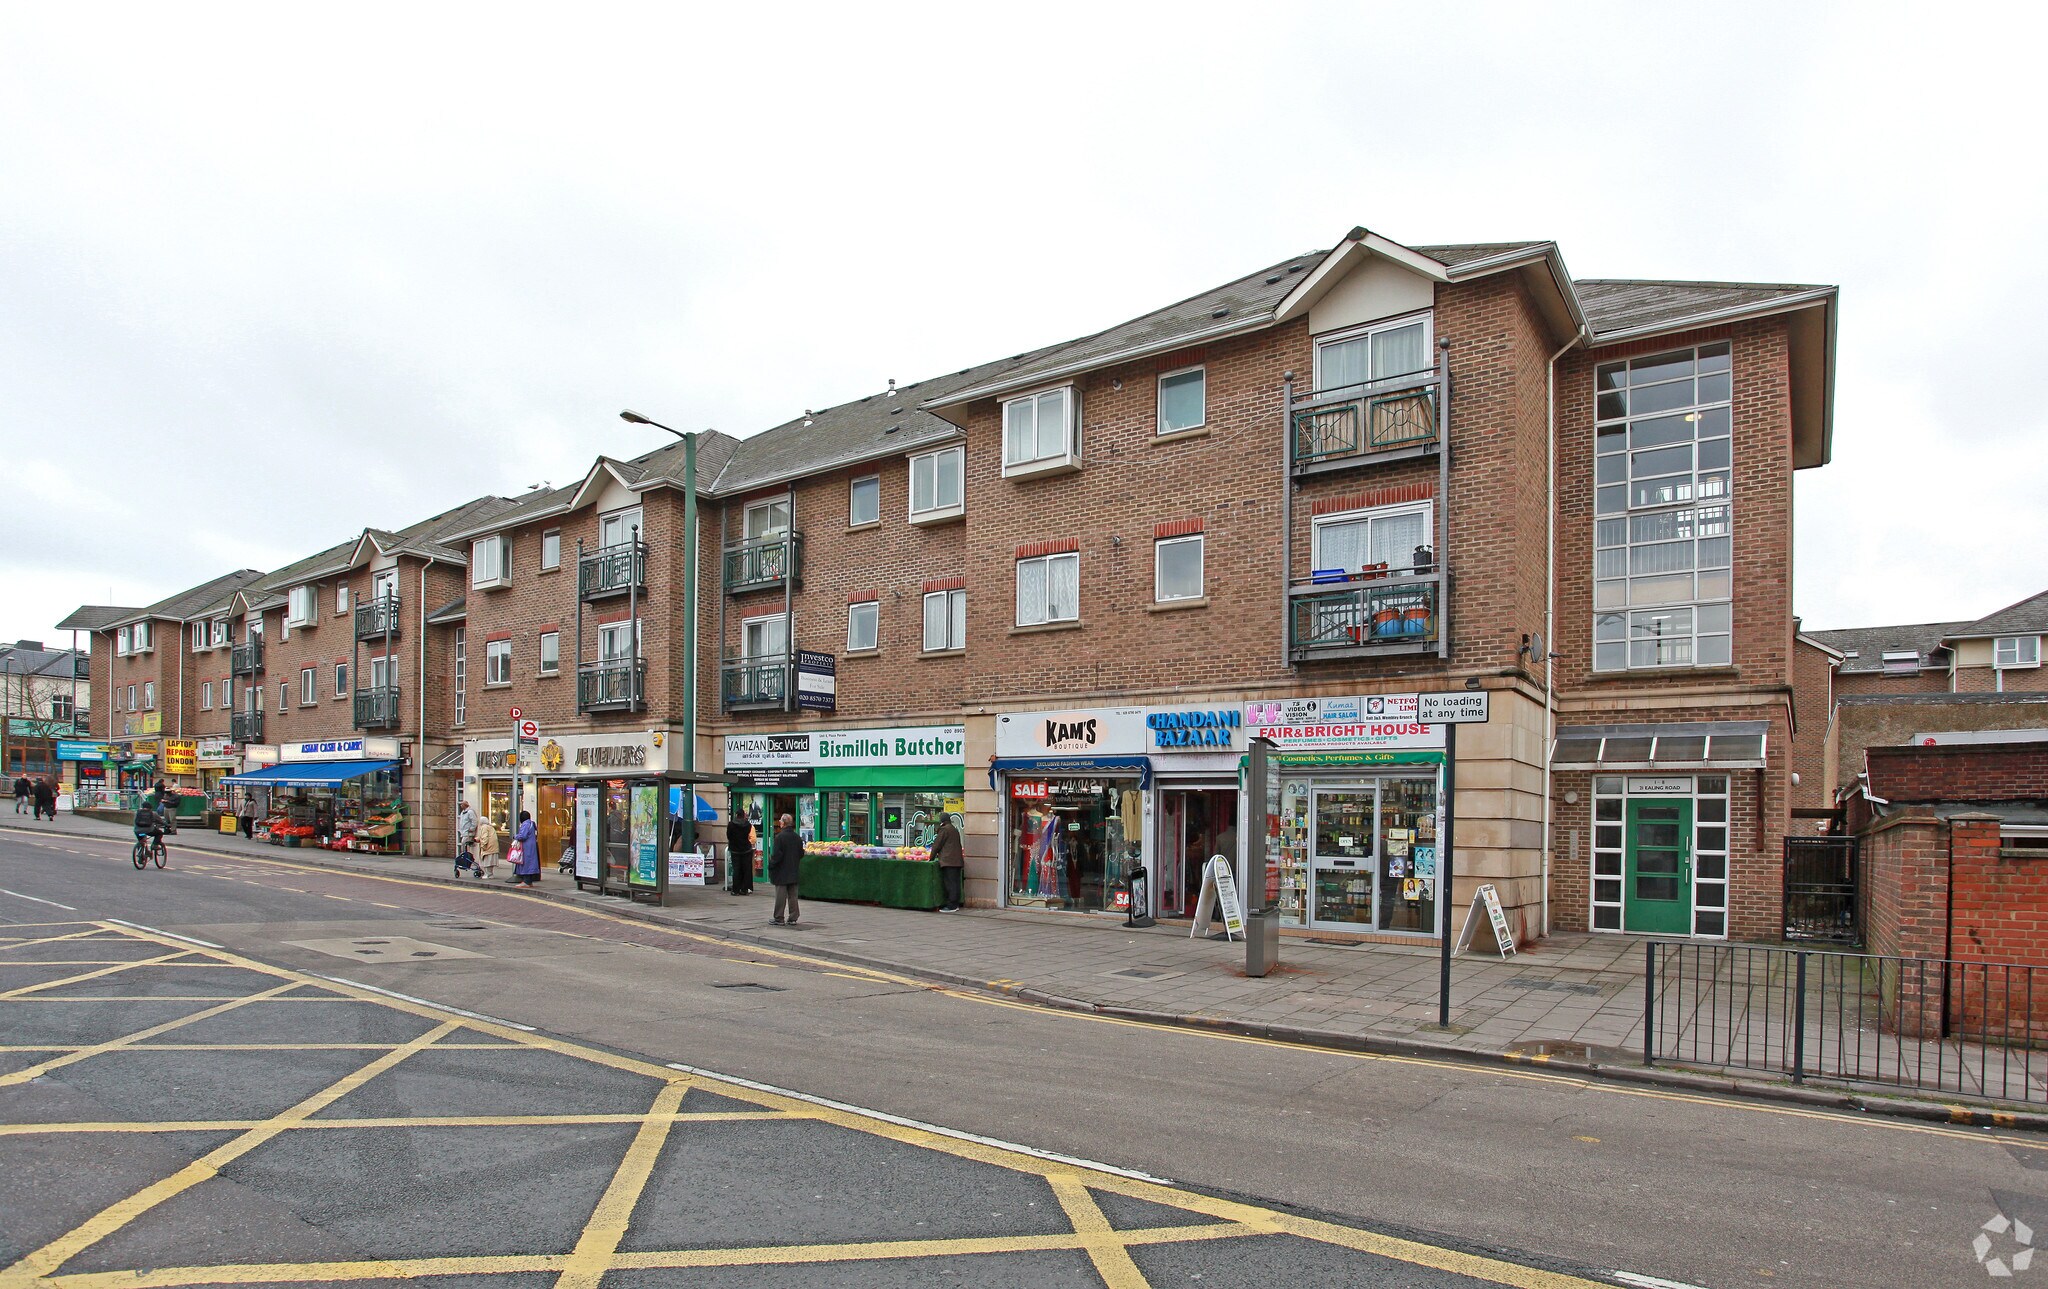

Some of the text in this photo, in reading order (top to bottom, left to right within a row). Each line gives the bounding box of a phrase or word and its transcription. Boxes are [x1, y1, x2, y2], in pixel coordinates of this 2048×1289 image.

[800, 653, 834, 663] Investco
[1424, 697, 1482, 707] No loading
[512, 708, 521, 717] D
[1338, 711, 1358, 719] SALON
[1422, 708, 1484, 719] at any time
[1146, 710, 1241, 730] CHANDANI
[1046, 718, 1097, 748] KAM'S
[1370, 723, 1431, 736] HOUSE
[167, 740, 193, 748] LAPTOP
[1155, 729, 1232, 747] BAZAAR
[301, 743, 319, 753] ASIAN
[320, 742, 336, 752] CASH
[337, 742, 343, 751] &
[727, 738, 808, 751] VAHIZAN Disc World
[819, 737, 962, 758] Bismillah Butcher
[166, 748, 195, 756] REPAIRS
[575, 745, 646, 767] JEWELLERS
[1014, 783, 1045, 796] SALE
